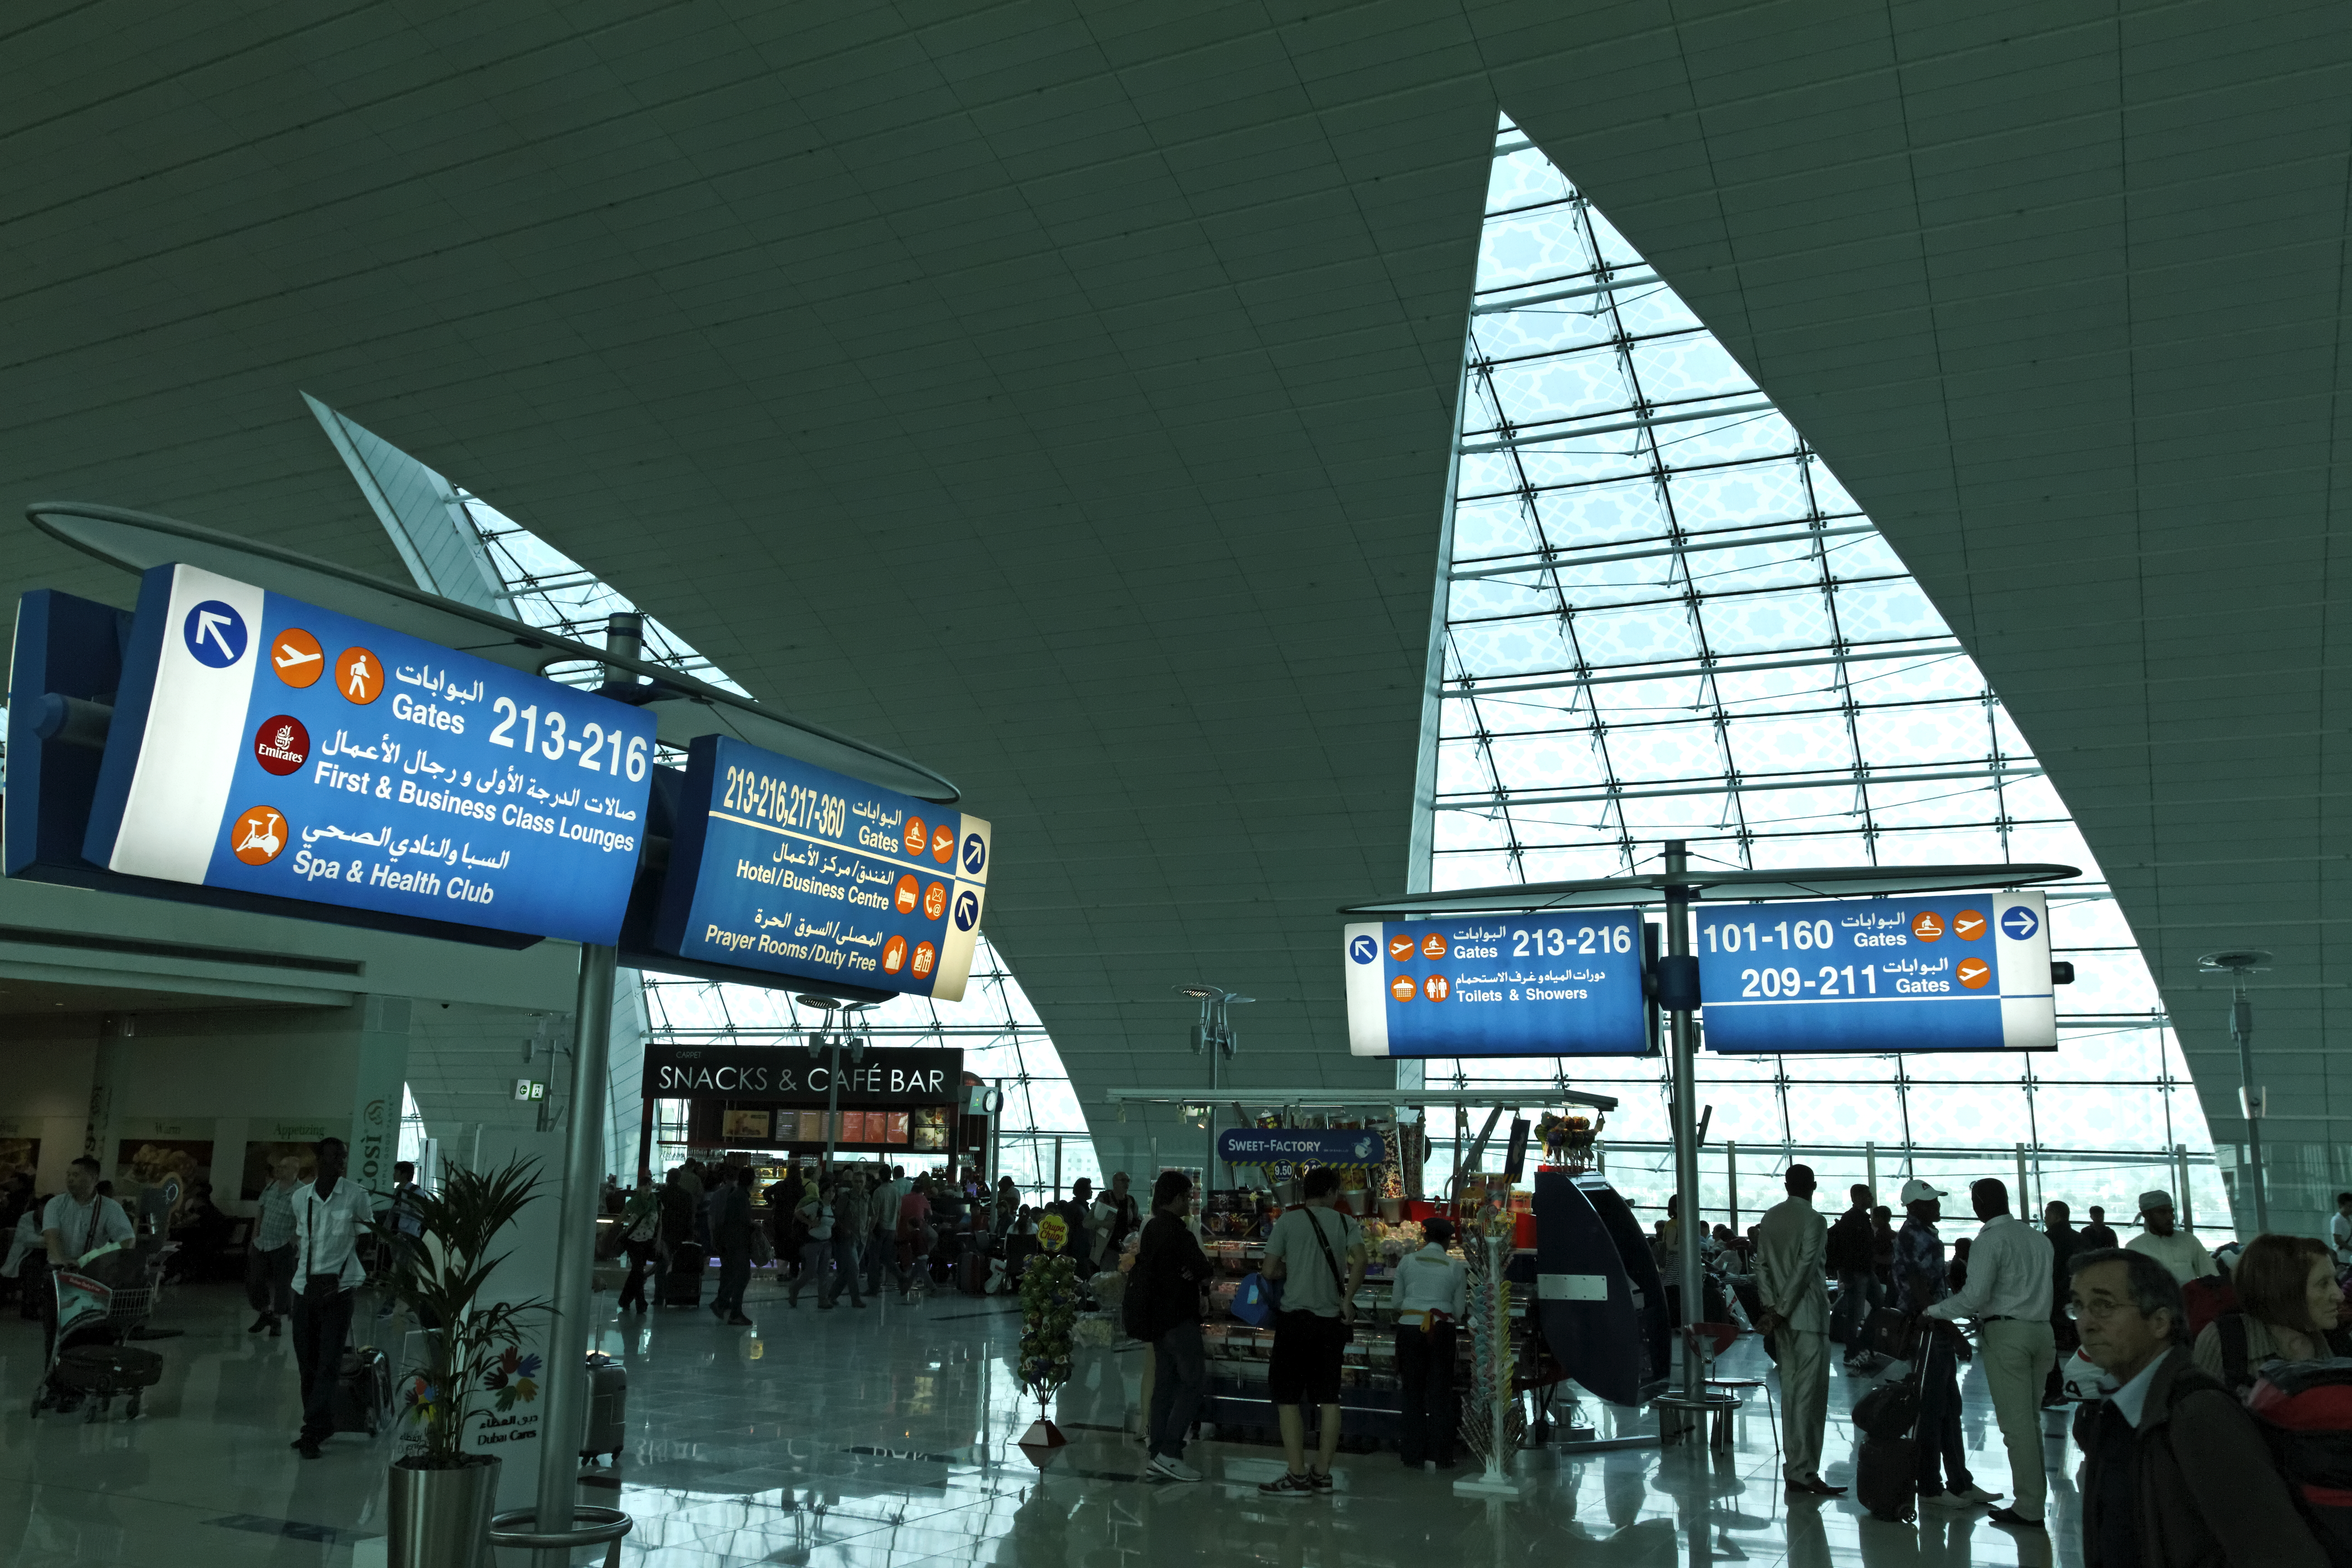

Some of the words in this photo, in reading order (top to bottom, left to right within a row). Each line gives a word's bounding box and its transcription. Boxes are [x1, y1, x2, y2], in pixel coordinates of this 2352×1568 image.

[396, 665, 484, 702] البوابات
[322, 729, 401, 764] الأعمال
[392, 693, 465, 735] Gates
[489, 696, 647, 782] 213-216
[258, 743, 303, 763] Emirates
[403, 749, 457, 784] رجال
[475, 765, 524, 795] الأولى
[526, 778, 580, 808] الدرجة
[723, 765, 845, 838] 213-216,217-360
[314, 760, 370, 795] First
[375, 775, 392, 799] &
[398, 780, 497, 822] Business
[502, 804, 555, 834] Class
[559, 816, 634, 853] Lounges
[584, 797, 636, 821] صالات
[852, 800, 902, 827] البوابات
[302, 825, 392, 849] الصحي
[858, 825, 899, 853] Gates
[388, 834, 458, 866] والنادي
[461, 842, 510, 869] السبا
[773, 842, 819, 867] الأعمال
[293, 850, 340, 881] Spa
[346, 860, 364, 883] &
[369, 863, 441, 896] Health
[446, 877, 494, 904] Club
[848, 886, 889, 911] Centre
[754, 908, 792, 929] الحرة
[1841, 911, 1905, 930] البوابات
[1453, 926, 1506, 942] البوابات
[1454, 945, 1498, 959] Gates
[1513, 925, 1631, 957] 213-216
[1704, 920, 1833, 953] 101-160
[1854, 932, 1907, 947] Gates
[705, 924, 756, 951] Prayer
[848, 951, 877, 971] Free
[1509, 971, 1536, 985] غرف
[1544, 969, 1572, 984] المياه
[1573, 969, 1606, 982] دورات
[1883, 957, 1949, 975] البوابات
[1455, 971, 1508, 990] الاستحمام
[1741, 965, 1876, 997] 209-211
[1896, 978, 1950, 993] Gates
[1456, 990, 1503, 1002] Toilets
[1509, 989, 1519, 1001] &
[1526, 988, 1588, 1000] Showers
[659, 1066, 766, 1090] SNACKS
[779, 1069, 797, 1091] &
[808, 1063, 881, 1092] CAFÉ
[891, 1069, 944, 1093] BAR
[273, 1122, 325, 1139] Appetizing
[1228, 1138, 1321, 1152] SWEET-FACTORY
[1274, 1165, 1292, 1176] 9.50
[1040, 1230, 1063, 1242] Chups
[1042, 1221, 1065, 1233] Chupa
[477, 1432, 507, 1446] Dubai
[510, 1430, 537, 1441] Cares
